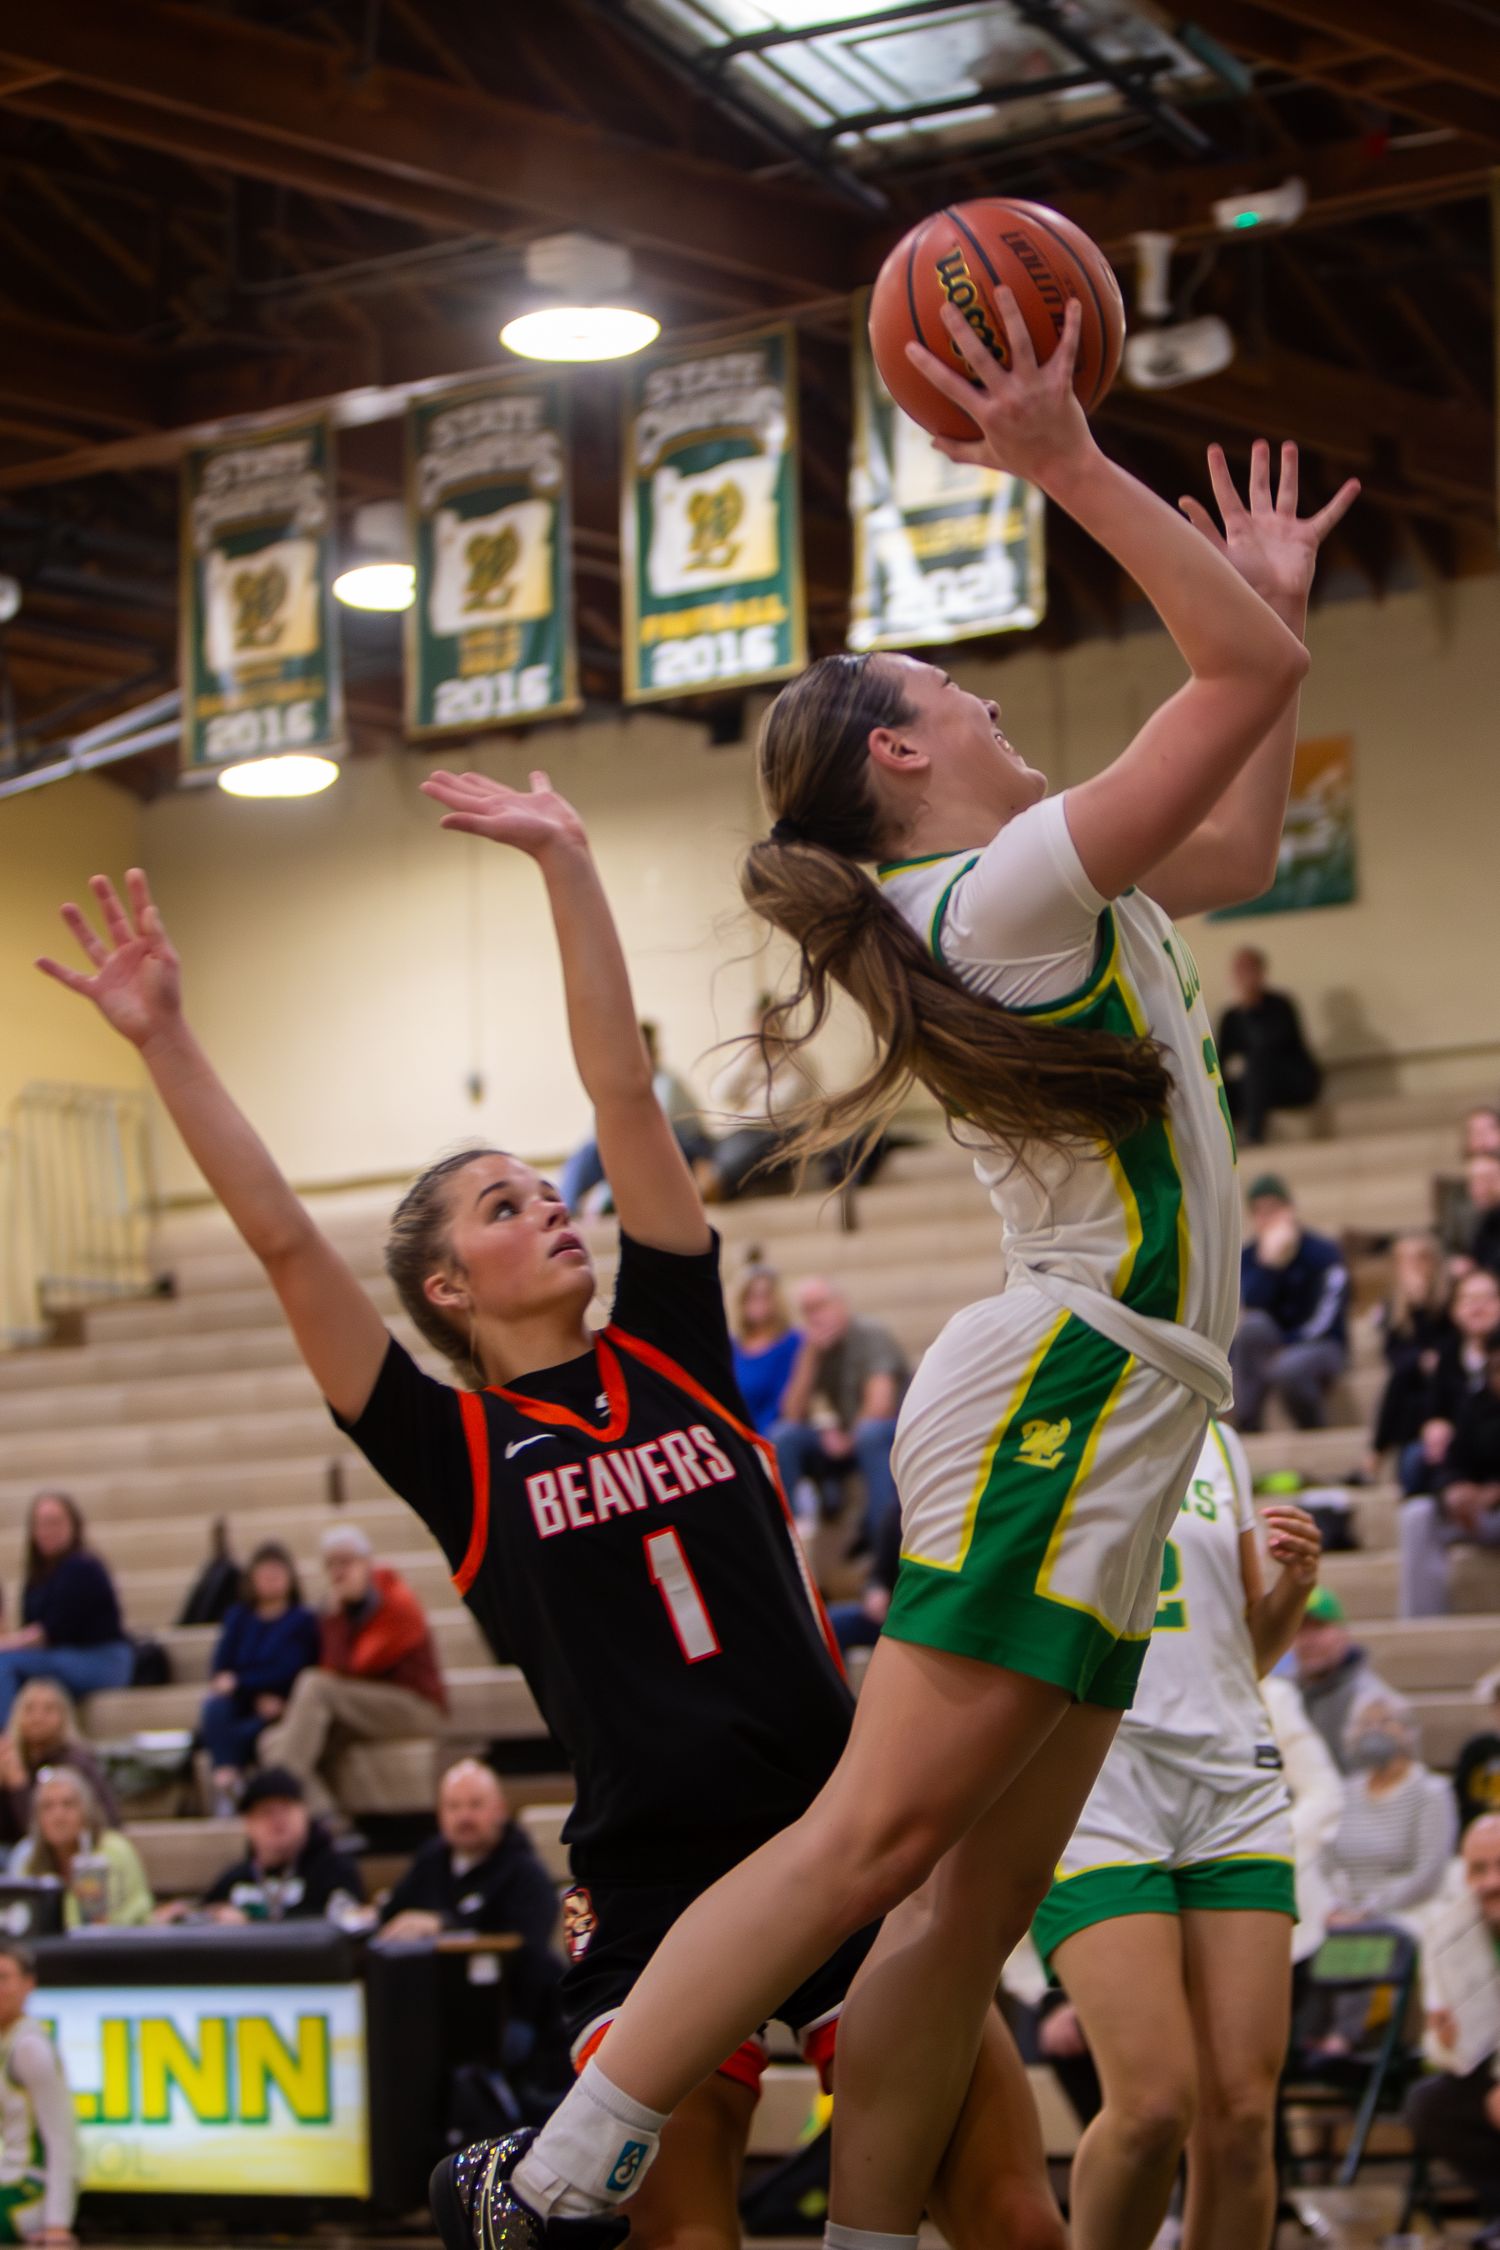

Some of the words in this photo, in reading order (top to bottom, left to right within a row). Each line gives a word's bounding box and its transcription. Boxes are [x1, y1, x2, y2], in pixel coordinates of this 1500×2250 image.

[651, 624, 778, 688] 2016
[434, 664, 551, 725] 2016
[204, 701, 316, 759] 2016
[525, 1424, 736, 1540] BEAVERS
[642, 1525, 723, 1665] 1
